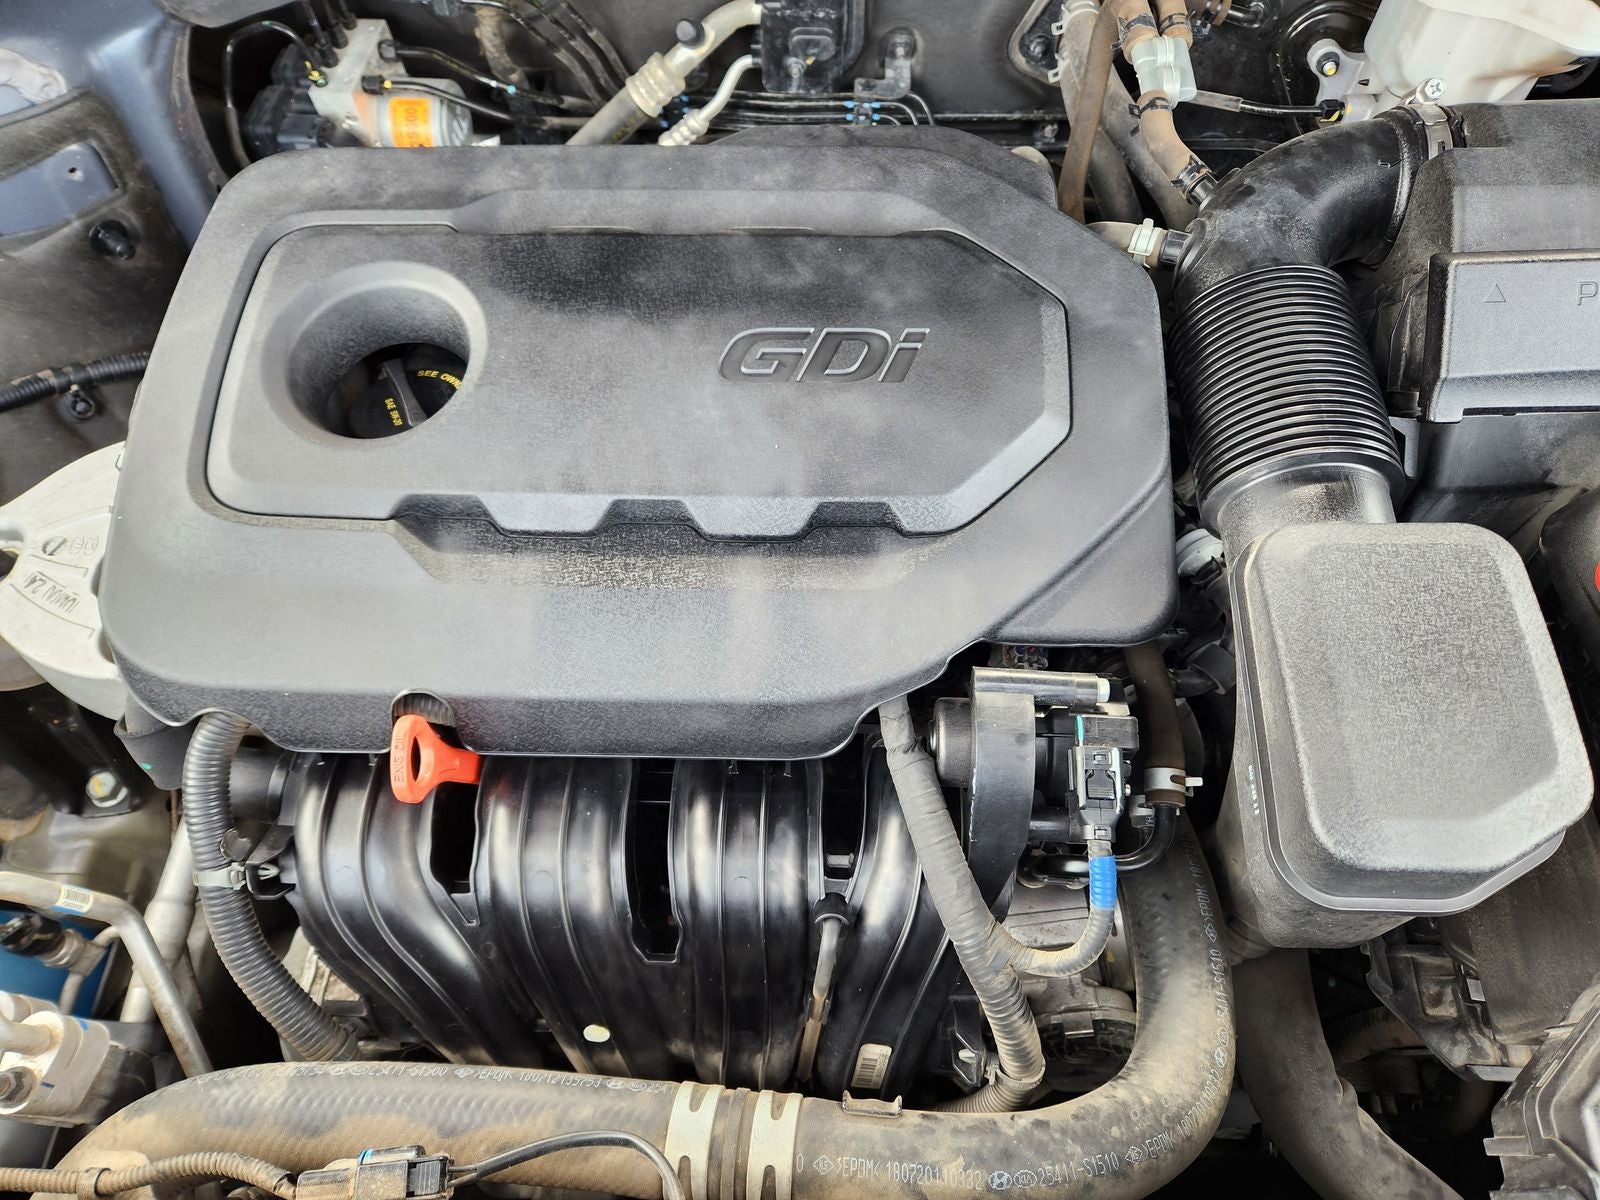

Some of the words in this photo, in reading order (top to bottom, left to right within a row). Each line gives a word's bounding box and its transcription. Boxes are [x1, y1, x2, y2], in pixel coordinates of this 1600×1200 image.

[1577, 281, 1599, 306] P
[718, 327, 930, 383] GDi
[417, 370, 440, 378] SEE
